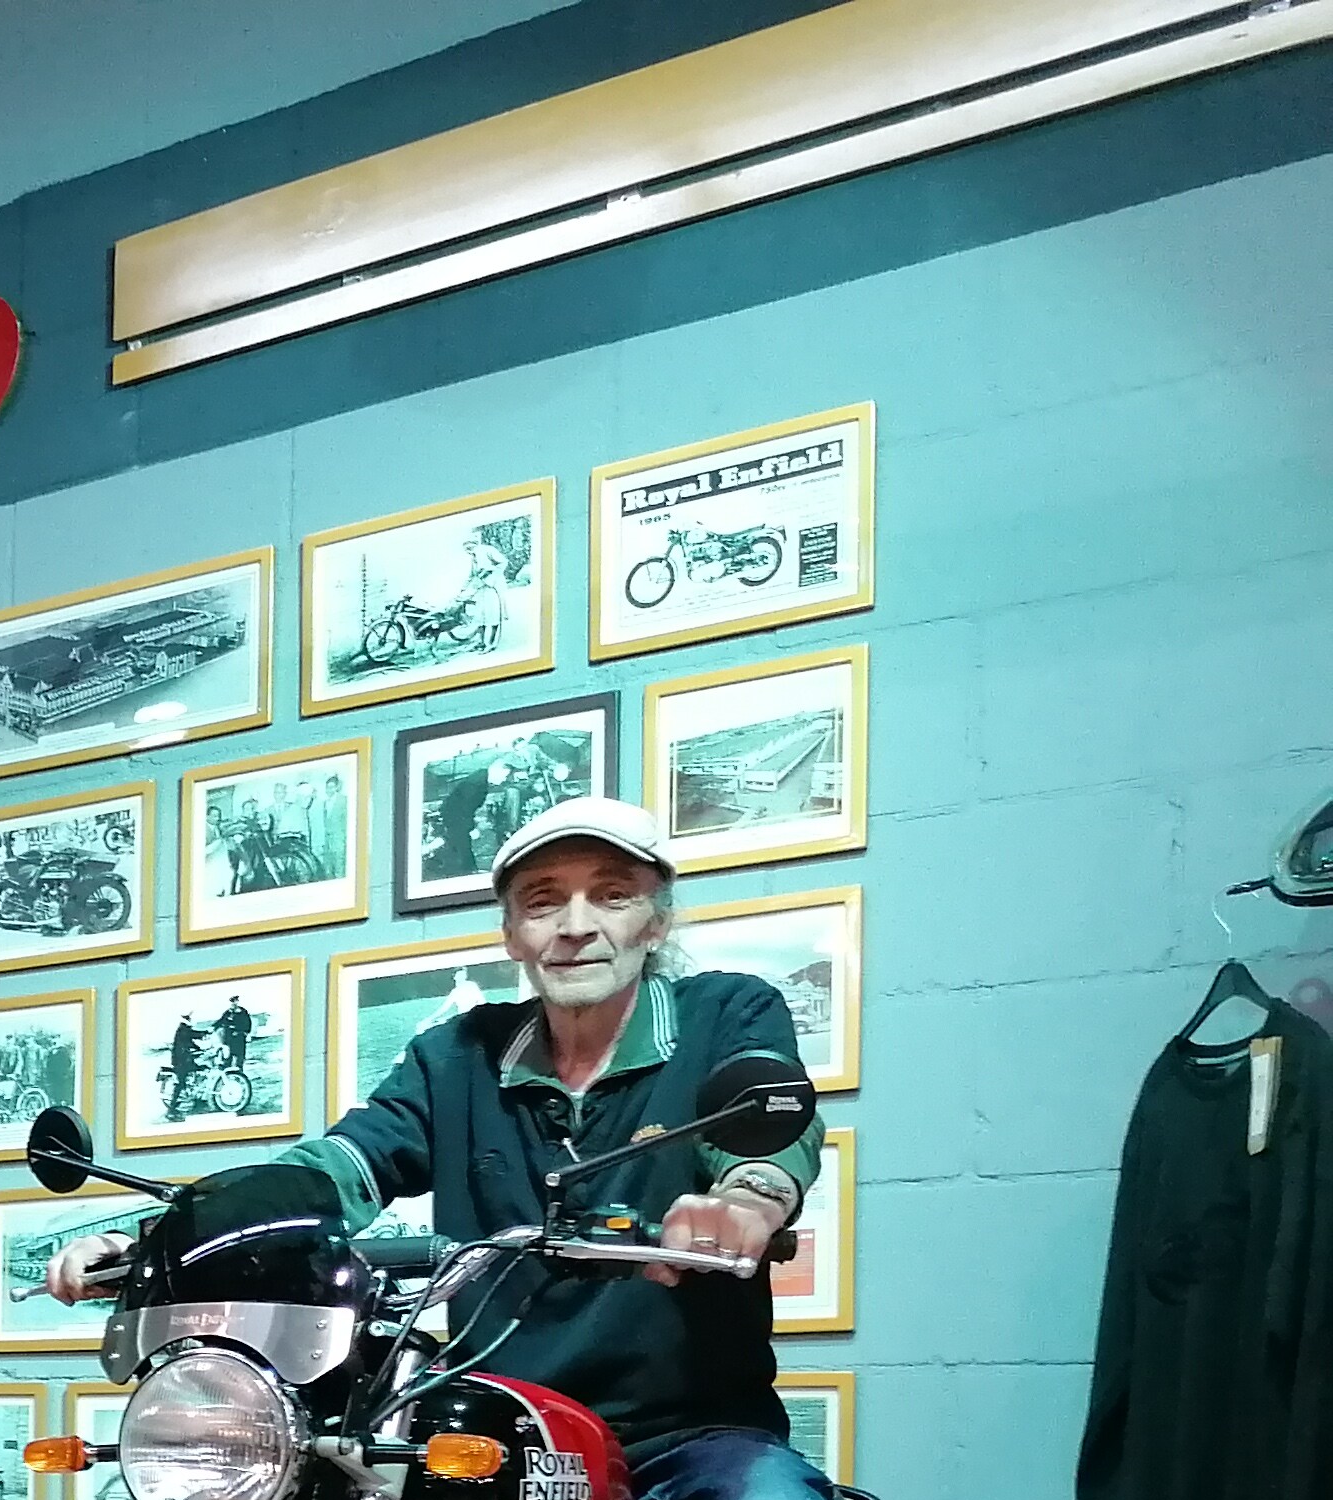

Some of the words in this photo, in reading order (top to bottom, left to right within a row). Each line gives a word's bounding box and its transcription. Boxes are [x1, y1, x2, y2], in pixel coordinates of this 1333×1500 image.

[622, 472, 713, 513] Royal
[718, 441, 843, 488] Enfield
[524, 1447, 588, 1479] ROYAL
